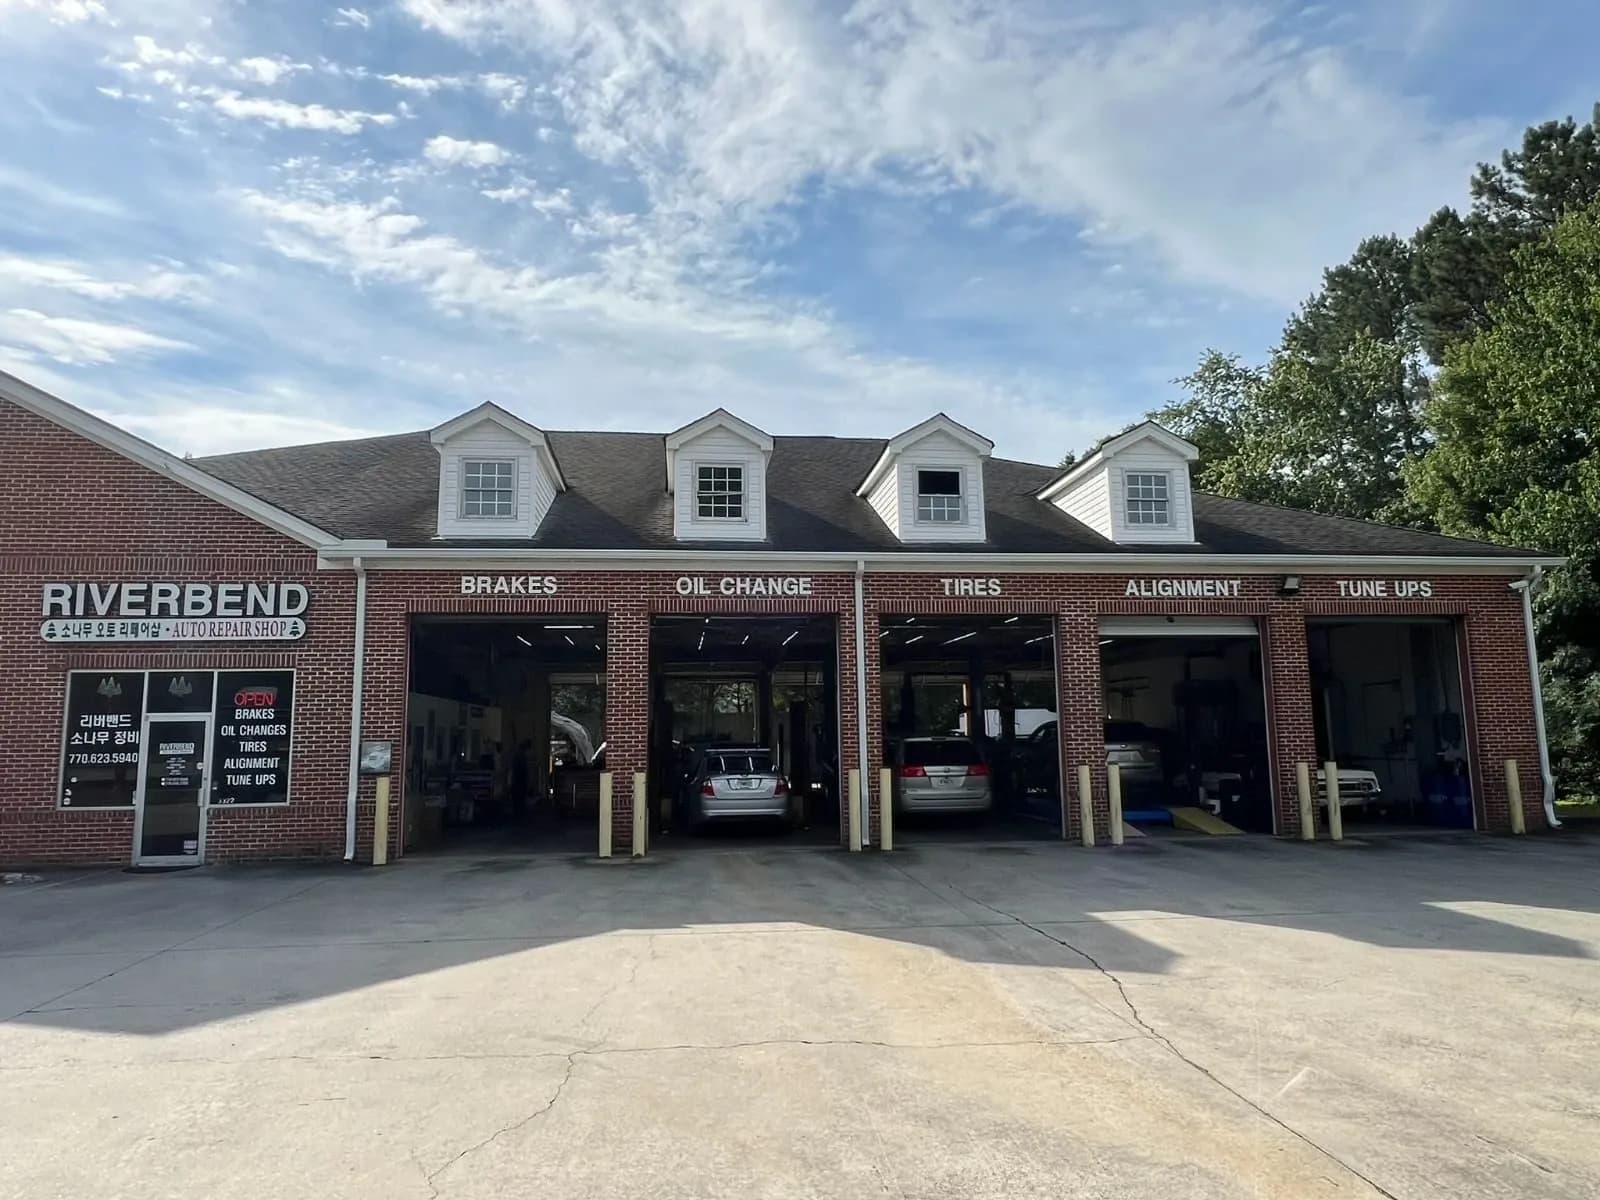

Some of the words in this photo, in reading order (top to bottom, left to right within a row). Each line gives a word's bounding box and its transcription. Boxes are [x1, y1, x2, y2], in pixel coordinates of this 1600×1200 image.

[461, 575, 558, 594] BRAKES
[676, 576, 712, 595] OIL
[720, 577, 812, 595] CHANGE
[940, 578, 1001, 596] TIRES
[1125, 579, 1241, 597] ALIGNMENT
[1336, 580, 1388, 597] TUNE
[1394, 580, 1433, 597] UPS
[42, 583, 309, 616] RIVERBEND
[61, 622, 92, 639] 소나무
[96, 622, 115, 638] 오토
[172, 621, 207, 638] AUTO
[208, 621, 252, 638] REPAIR
[254, 620, 288, 637] SHOP
[234, 691, 274, 706] OPEN
[234, 708, 275, 720] BRAKES
[70, 731, 110, 745] 소나무
[113, 730, 140, 745] 정비
[220, 725, 237, 737] OIL
[239, 724, 287, 736] CHANGES
[239, 741, 268, 753] TIRES
[68, 752, 139, 764] 770.623.5940
[223, 757, 281, 769] ALIGNMENT
[225, 774, 253, 786] TUNE
[255, 774, 277, 786] UPS
